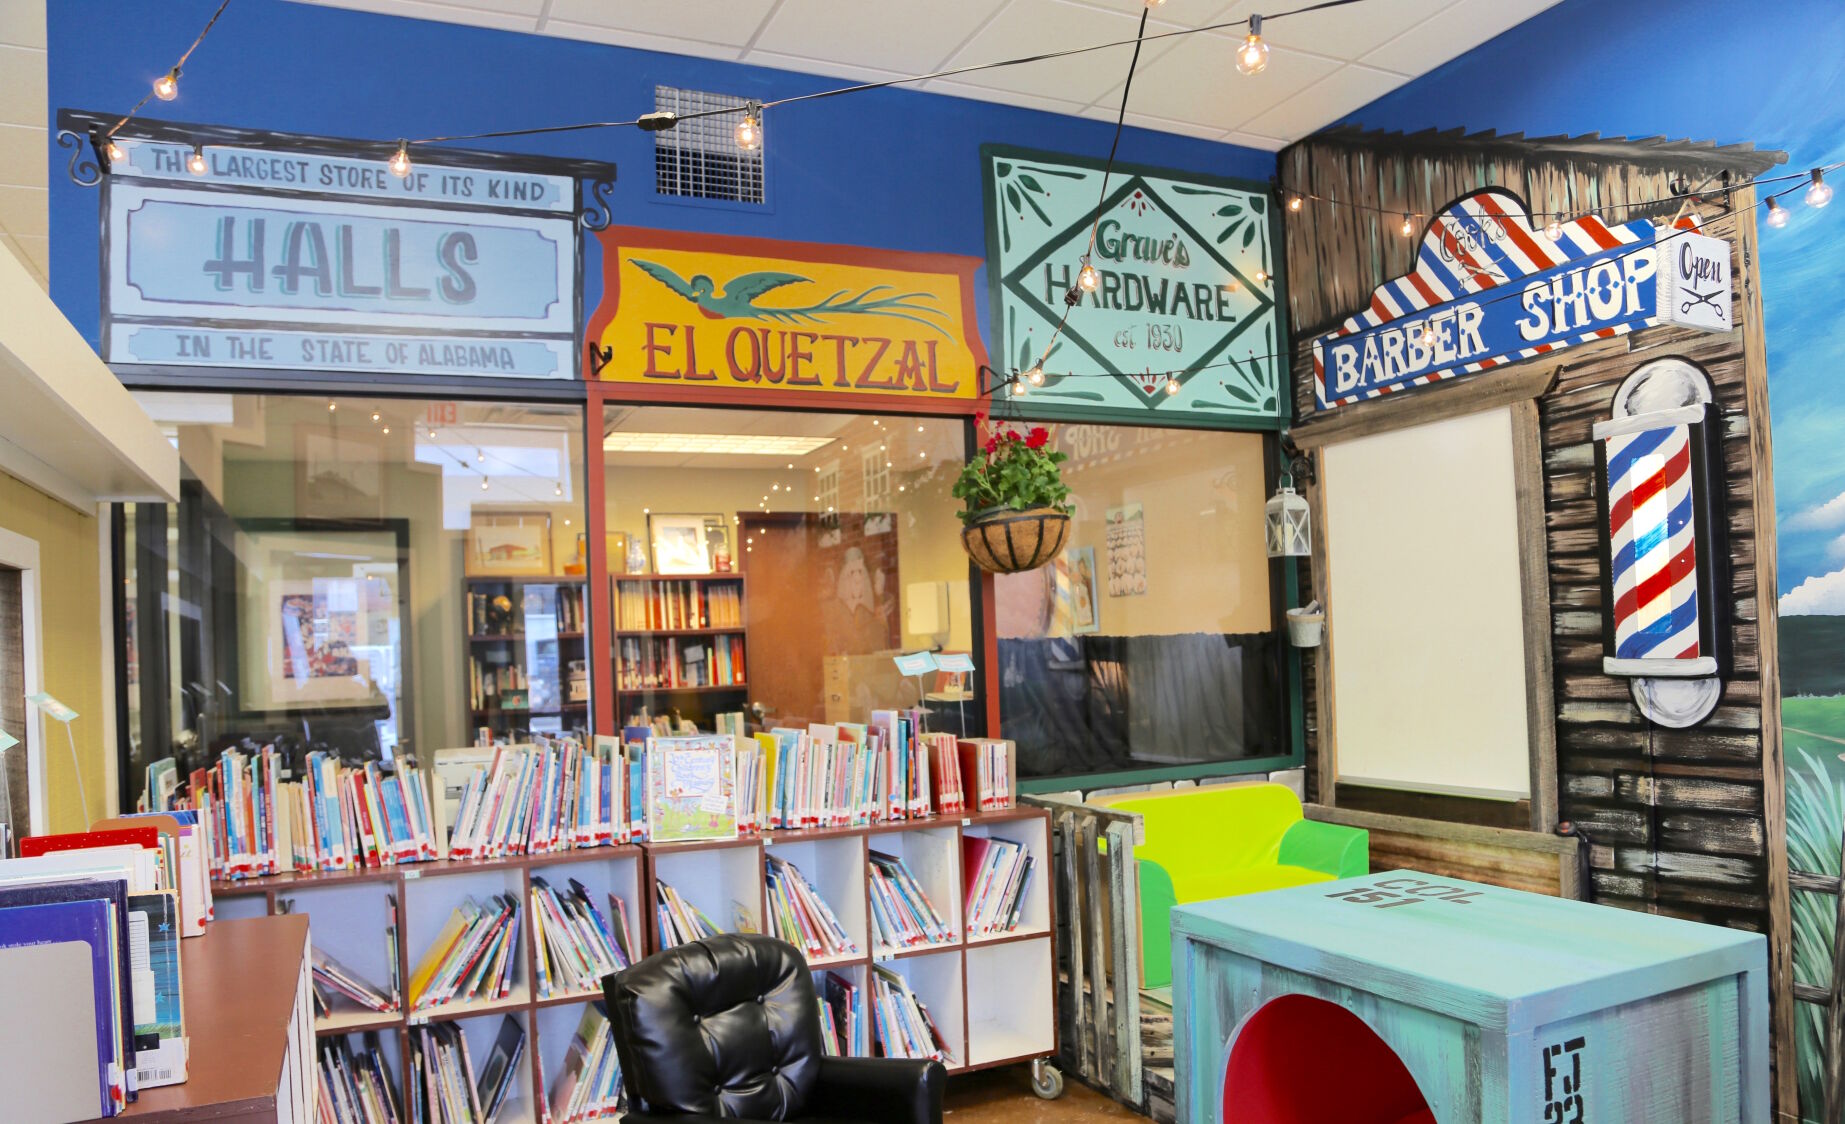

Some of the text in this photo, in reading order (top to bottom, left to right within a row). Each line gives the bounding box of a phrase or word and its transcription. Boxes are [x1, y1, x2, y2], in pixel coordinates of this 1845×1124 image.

[212, 153, 310, 184] LARGEST
[319, 163, 387, 191] STORE
[402, 172, 430, 193] OF
[441, 175, 474, 198] ITS
[488, 178, 546, 202] KIND
[202, 214, 479, 305] HALLS
[1678, 241, 1723, 291] Open
[1146, 322, 1184, 353] 1930
[1331, 248, 1657, 394] BARBER SHOP
[176, 335, 516, 370] IN THE STATE OF ALABAMA
[641, 321, 961, 394] EL QUETZAL
